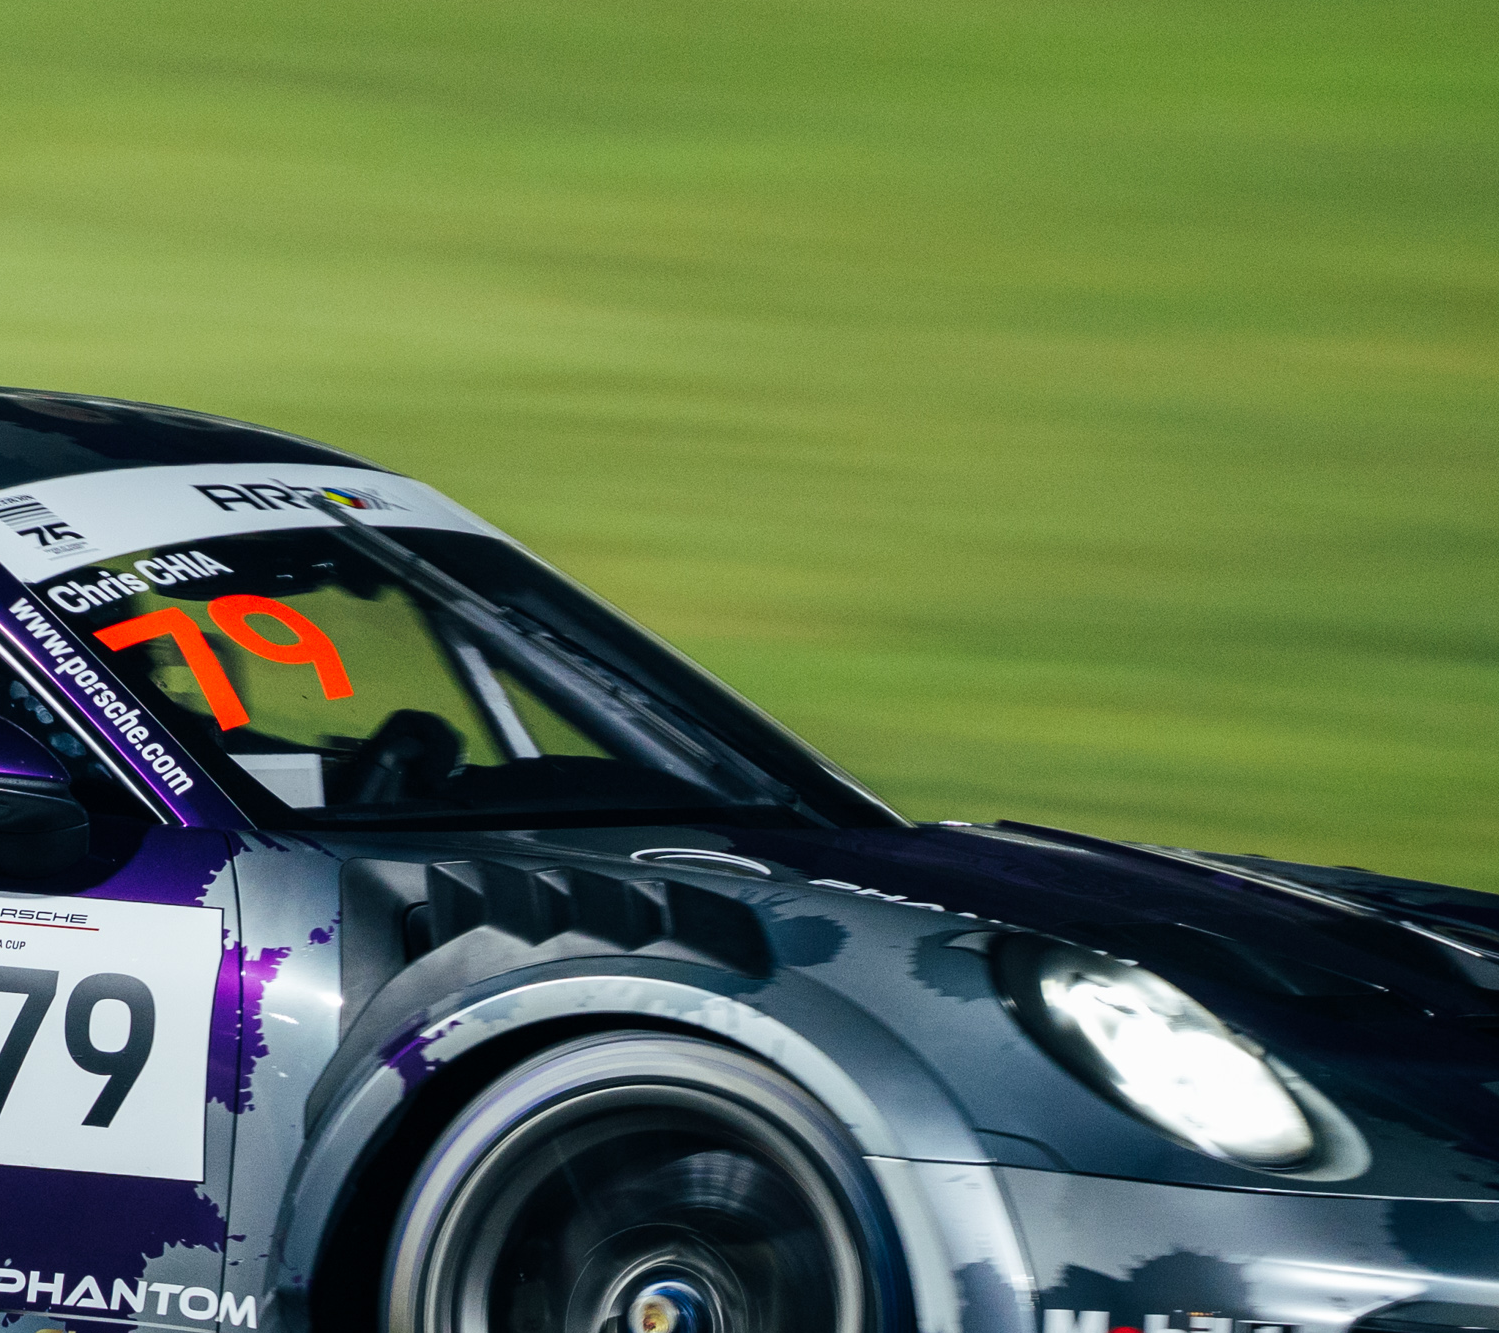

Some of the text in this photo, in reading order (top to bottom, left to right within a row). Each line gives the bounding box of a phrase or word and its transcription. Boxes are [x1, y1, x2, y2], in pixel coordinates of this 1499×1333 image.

[16, 522, 86, 546] 75
[47, 550, 234, 613] Chris CHIA
[92, 594, 355, 732] 79
[8, 597, 194, 796] www.porsche.com
[5, 940, 26, 950] CUP
